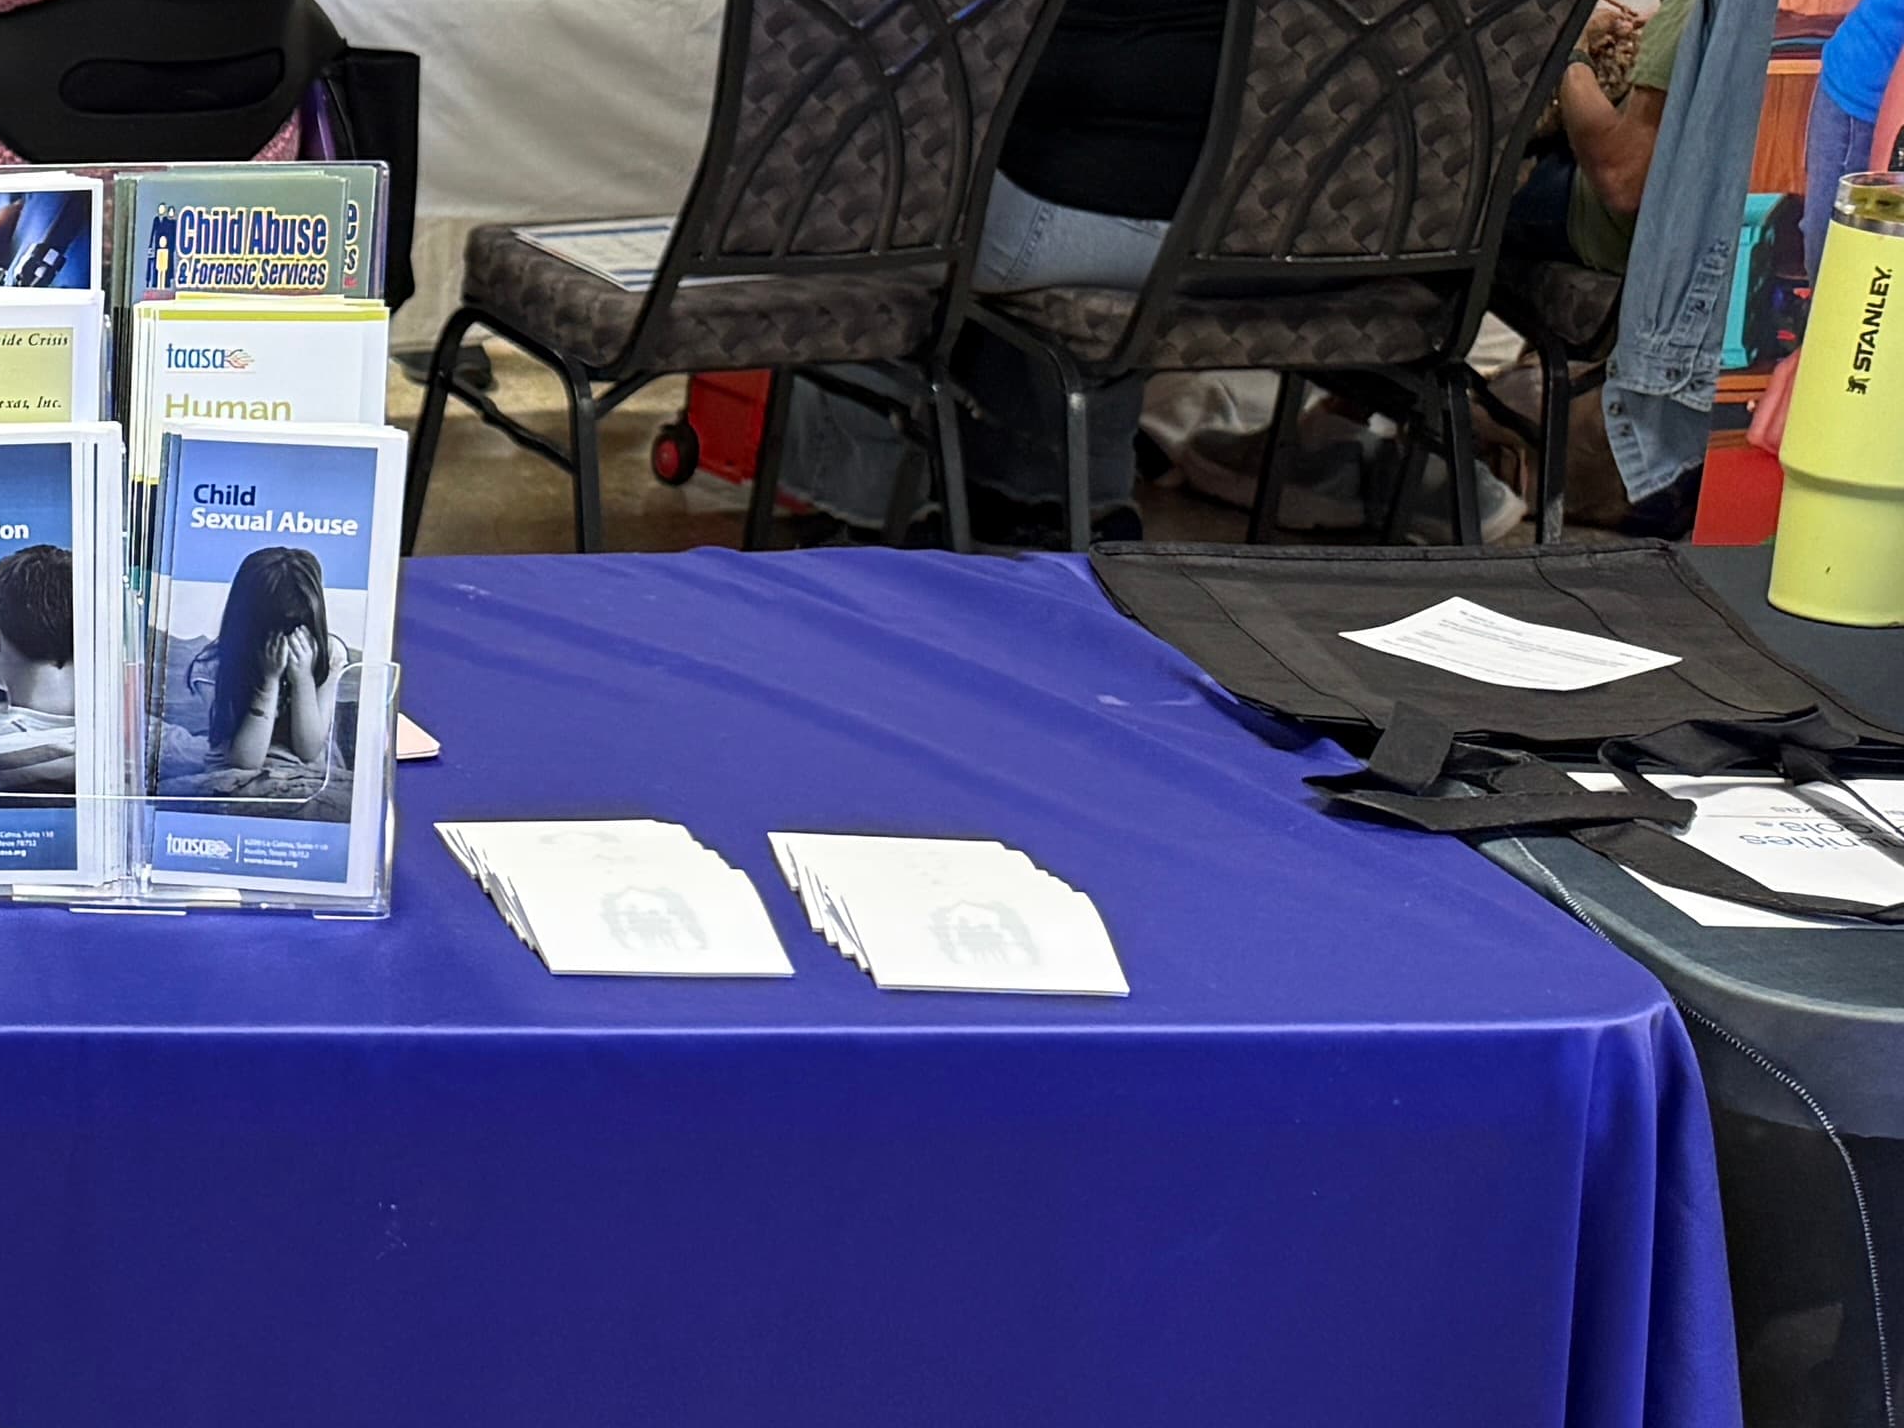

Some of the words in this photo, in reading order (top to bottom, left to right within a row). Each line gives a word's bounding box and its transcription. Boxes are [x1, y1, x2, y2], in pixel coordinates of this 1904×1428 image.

[177, 206, 245, 258] Child
[247, 207, 328, 259] Abuse
[177, 258, 190, 287] &
[192, 257, 257, 288] Forensic
[258, 258, 328, 288] Services
[28, 332, 69, 348] Crisis
[166, 343, 226, 370] taasa
[37, 396, 62, 410] Inc.
[165, 393, 293, 421] Human
[192, 483, 256, 508] Child
[191, 507, 272, 533] Sexual
[278, 511, 359, 537] Abuse
